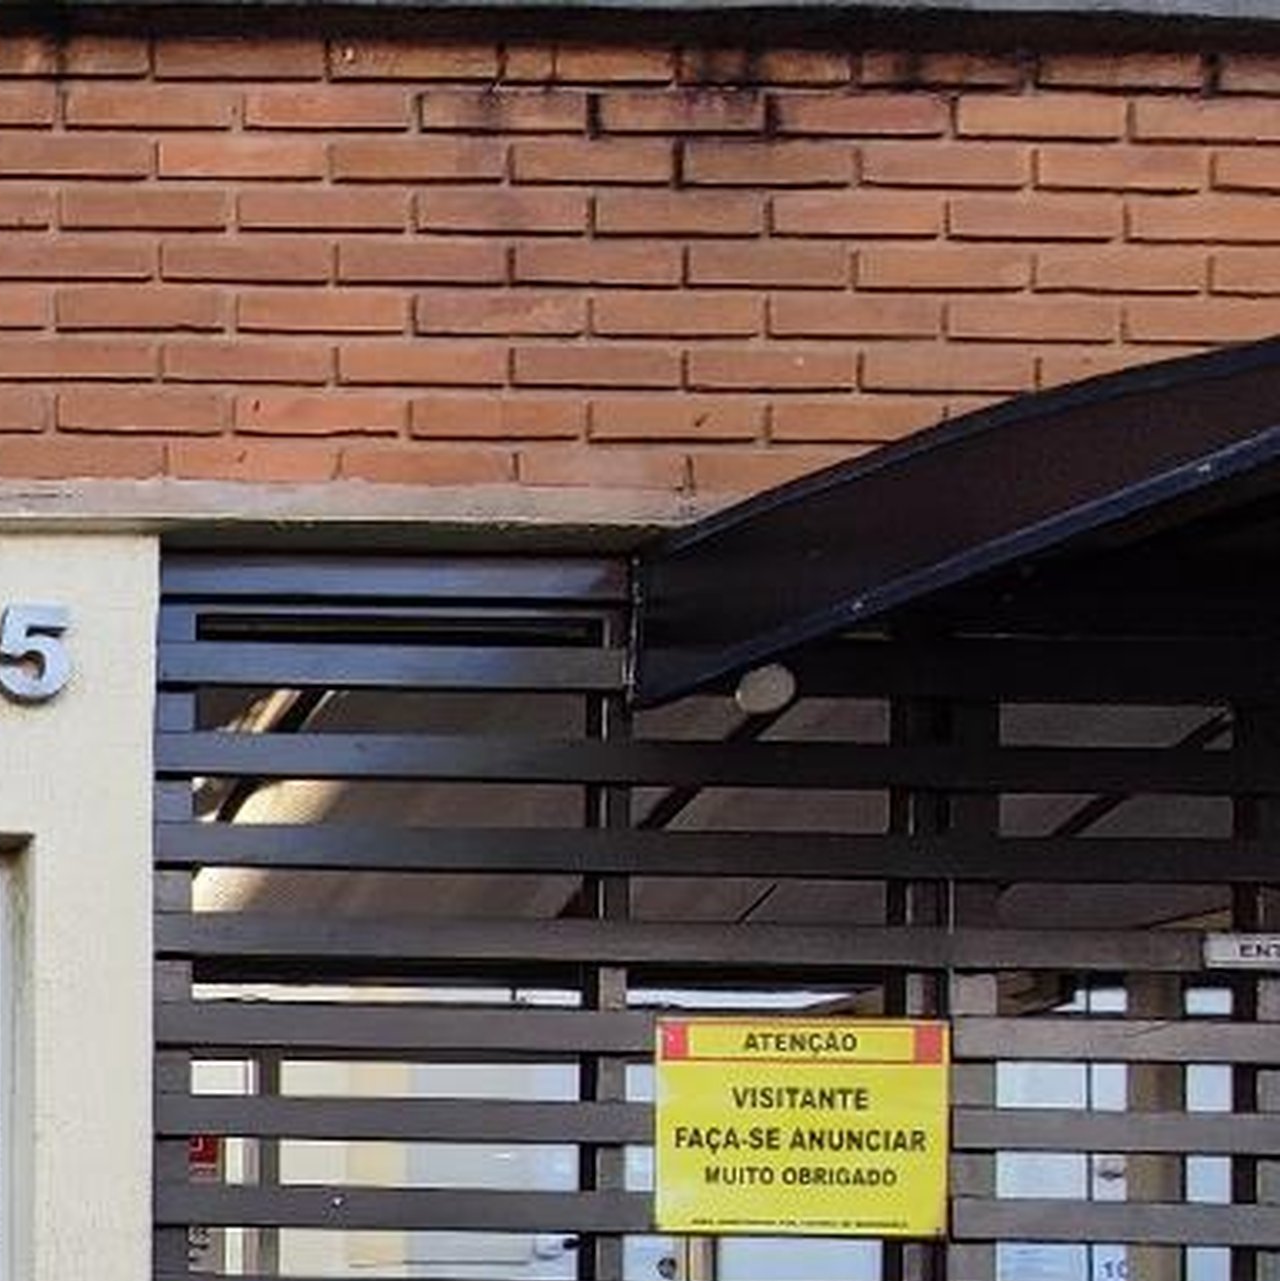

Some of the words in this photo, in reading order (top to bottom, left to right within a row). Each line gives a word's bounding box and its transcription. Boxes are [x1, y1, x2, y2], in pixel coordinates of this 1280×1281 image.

[744, 1032, 858, 1055] ATENÇÃO
[732, 1086, 870, 1110] VISITANTE
[675, 1127, 781, 1154] FAÇA-SE
[789, 1129, 927, 1153] ANUNCIAR
[705, 1166, 775, 1186] MUITO
[782, 1166, 898, 1187] OBRIGADO
